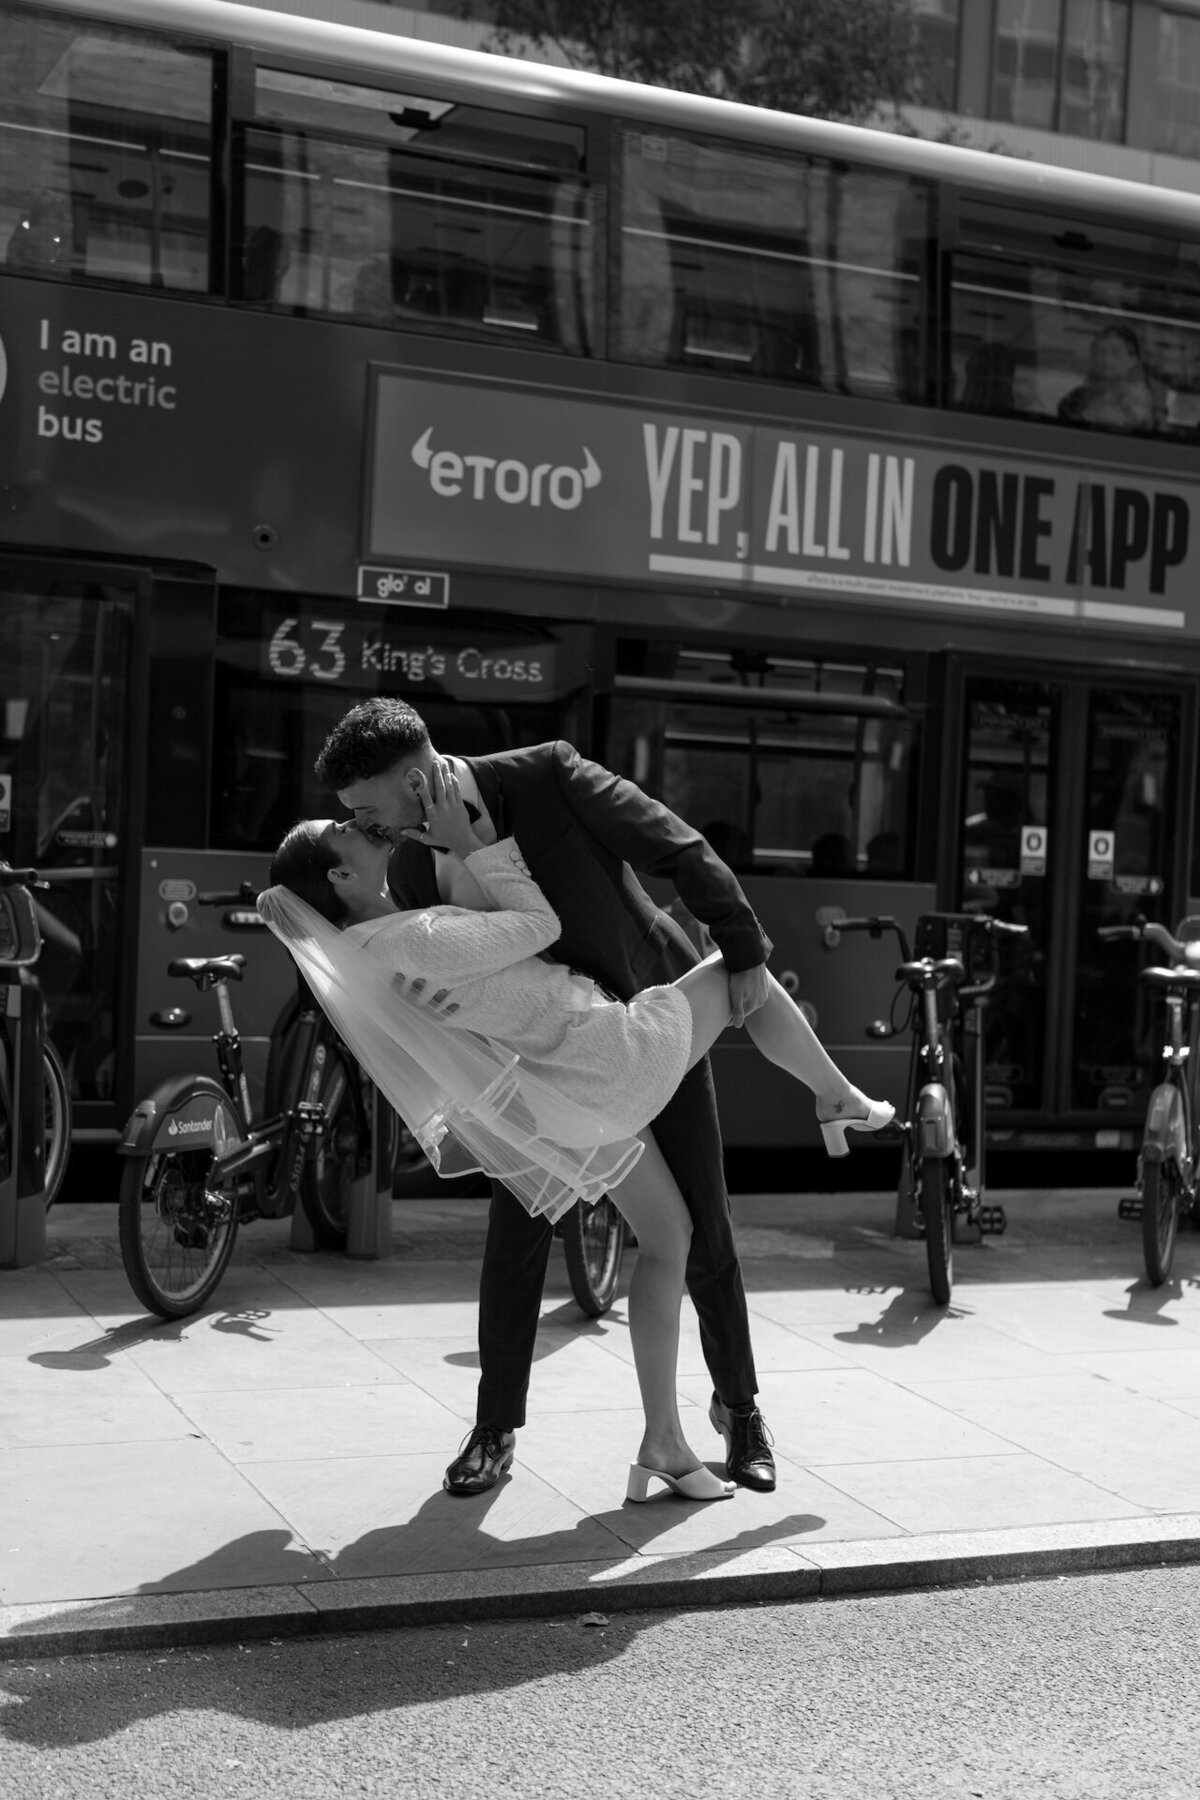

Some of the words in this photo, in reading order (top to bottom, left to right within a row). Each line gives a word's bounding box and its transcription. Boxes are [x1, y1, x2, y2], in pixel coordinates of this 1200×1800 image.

[40, 319, 49, 350] I
[61, 330, 117, 359] am
[128, 338, 172, 367] an
[38, 366, 177, 410] electric
[37, 406, 103, 443] bus
[643, 423, 749, 560] YEP,
[765, 441, 850, 560] ALL
[863, 453, 915, 567] IN
[930, 464, 1055, 583] ONE
[1066, 482, 1189, 595] APP
[268, 618, 346, 680] 63
[361, 641, 446, 682] King's
[456, 648, 544, 683] Cross
[178, 1118, 213, 1135] Santander
